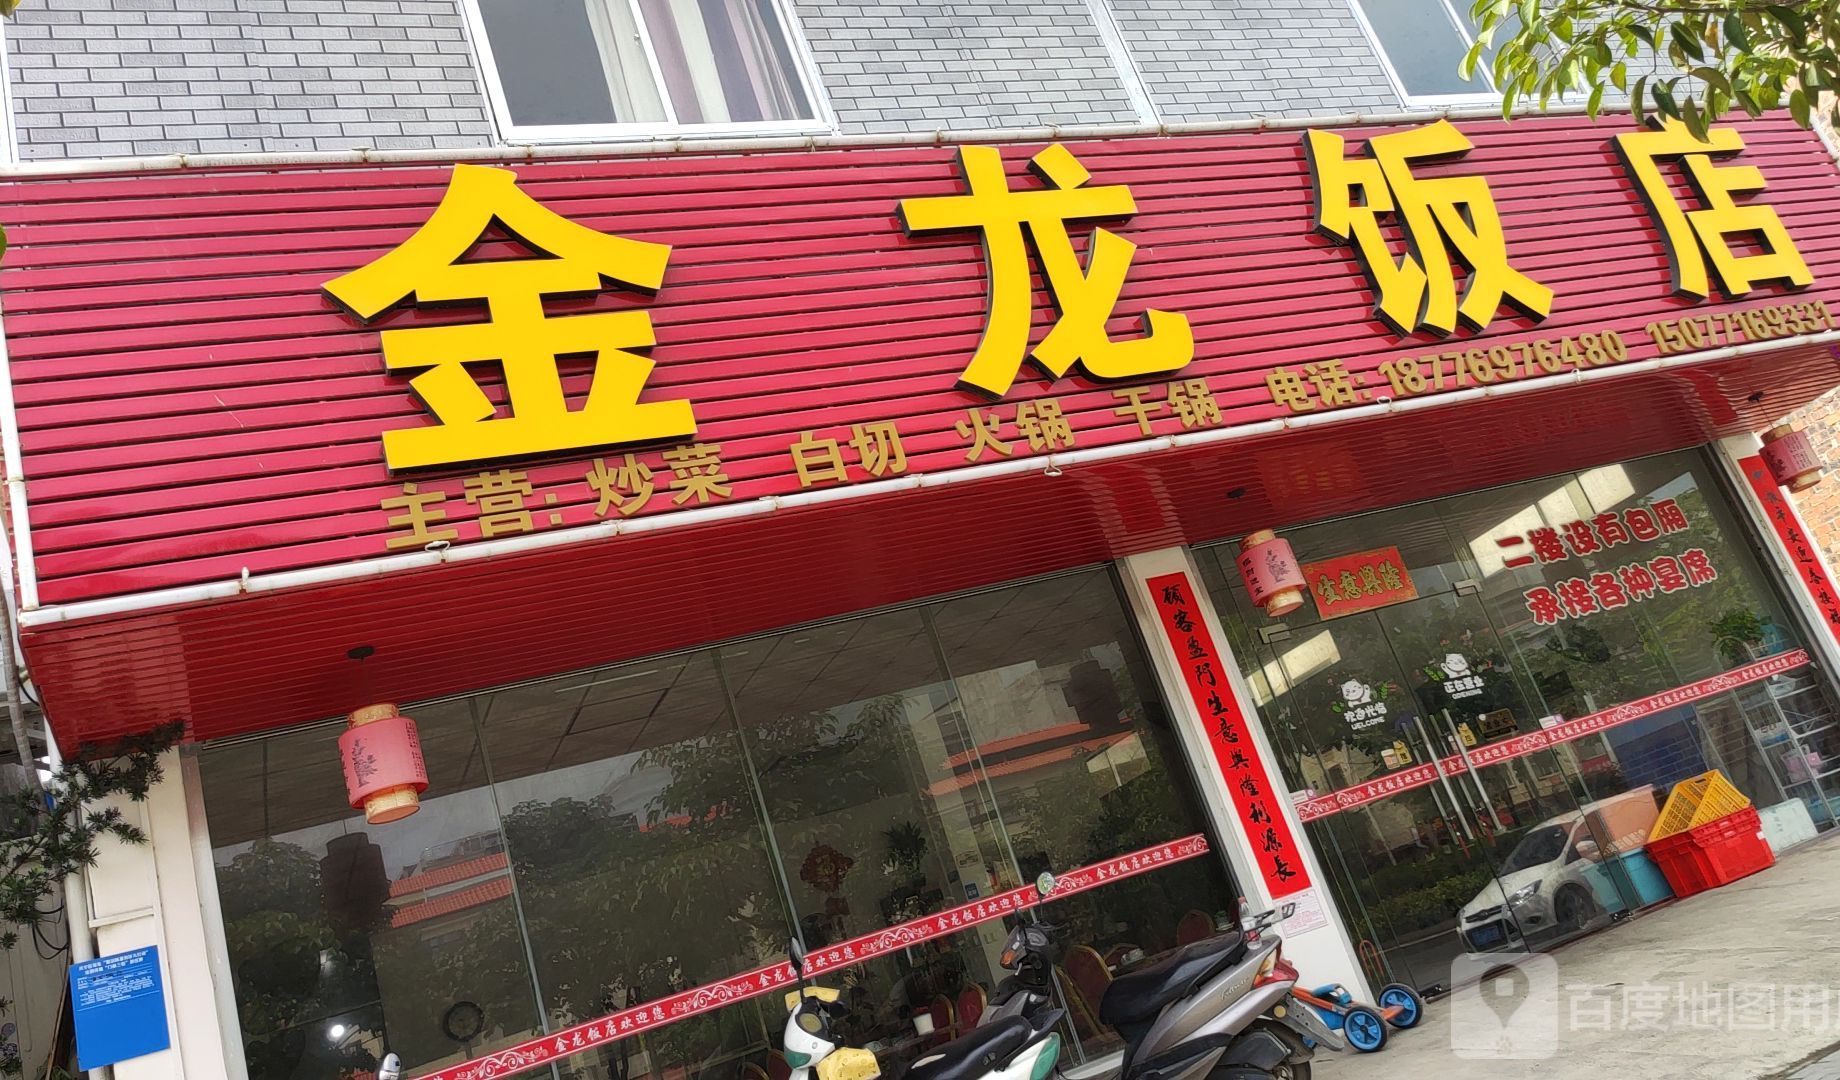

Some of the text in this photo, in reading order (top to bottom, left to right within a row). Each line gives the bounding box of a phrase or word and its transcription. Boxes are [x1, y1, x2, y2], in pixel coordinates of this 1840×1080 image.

[321, 116, 1815, 474] 金龙饭店
[586, 443, 734, 517] 炒菜
[790, 421, 908, 487] 白切
[955, 399, 1075, 461] 火锅
[1112, 378, 1224, 436] 干锅
[1378, 330, 1628, 395] 18776976480
[1645, 300, 1835, 354] 15077169331
[1494, 497, 1690, 569] 二楼设有包厢
[1523, 548, 1717, 626] 承接各种宴席
[1443, 675, 1486, 694] 正在营业
[1343, 702, 1388, 723] 欢迎光临
[1350, 716, 1386, 731] WELCOME
[1096, 847, 1175, 880] 金龙饭店欢迎您
[936, 892, 1024, 931] 金龙饭店欢迎您
[554, 1005, 666, 1053] 金龙饭店欢迎您
